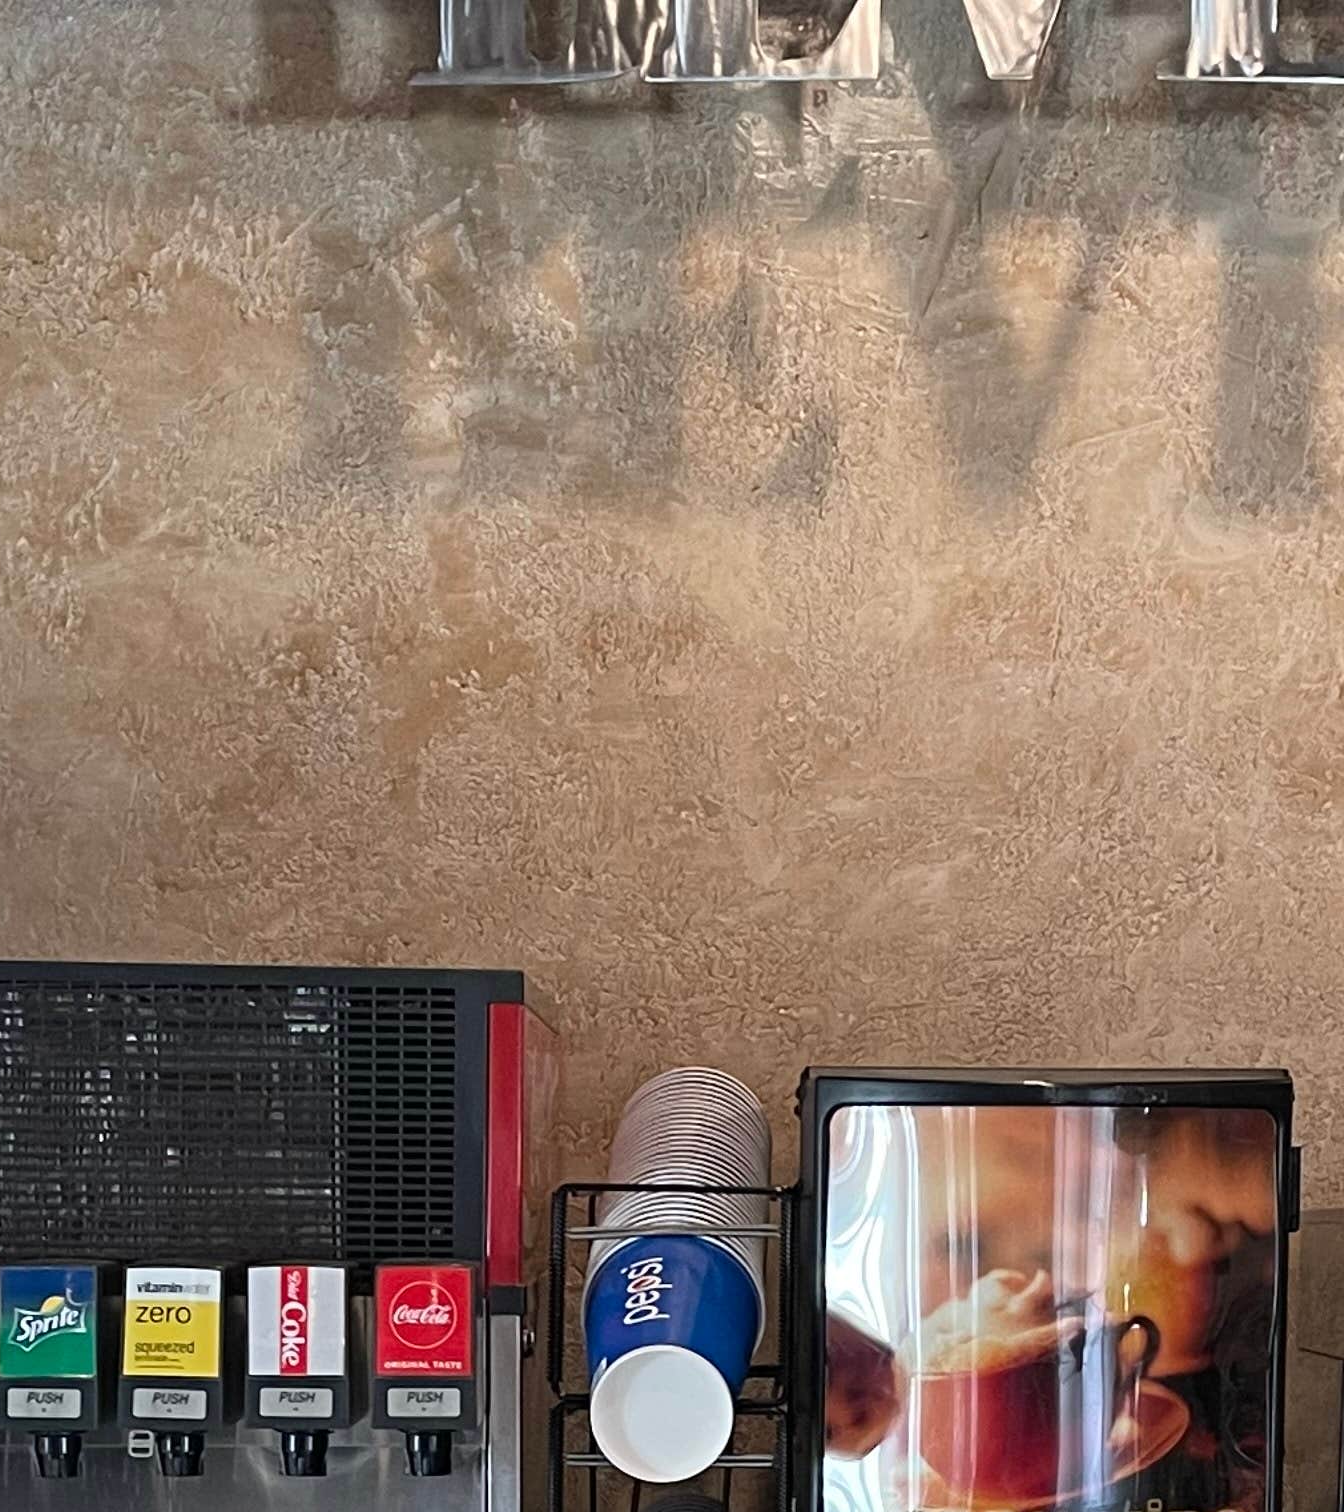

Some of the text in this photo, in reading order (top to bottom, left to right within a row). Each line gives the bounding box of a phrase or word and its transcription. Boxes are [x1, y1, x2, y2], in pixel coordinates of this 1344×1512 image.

[620, 1257, 673, 1325] pepsi
[135, 1306, 191, 1324] zero
[393, 1304, 453, 1325] Coca-Cola
[16, 1306, 79, 1342] Sprite
[281, 1301, 307, 1367] Coke
[134, 1341, 195, 1356] squeezed
[384, 1360, 462, 1370] ORIGINAL TASTE
[26, 1391, 64, 1404] PUSH
[152, 1391, 190, 1405] PUSH
[279, 1391, 316, 1404] PUSH
[407, 1391, 444, 1404] PUSH
